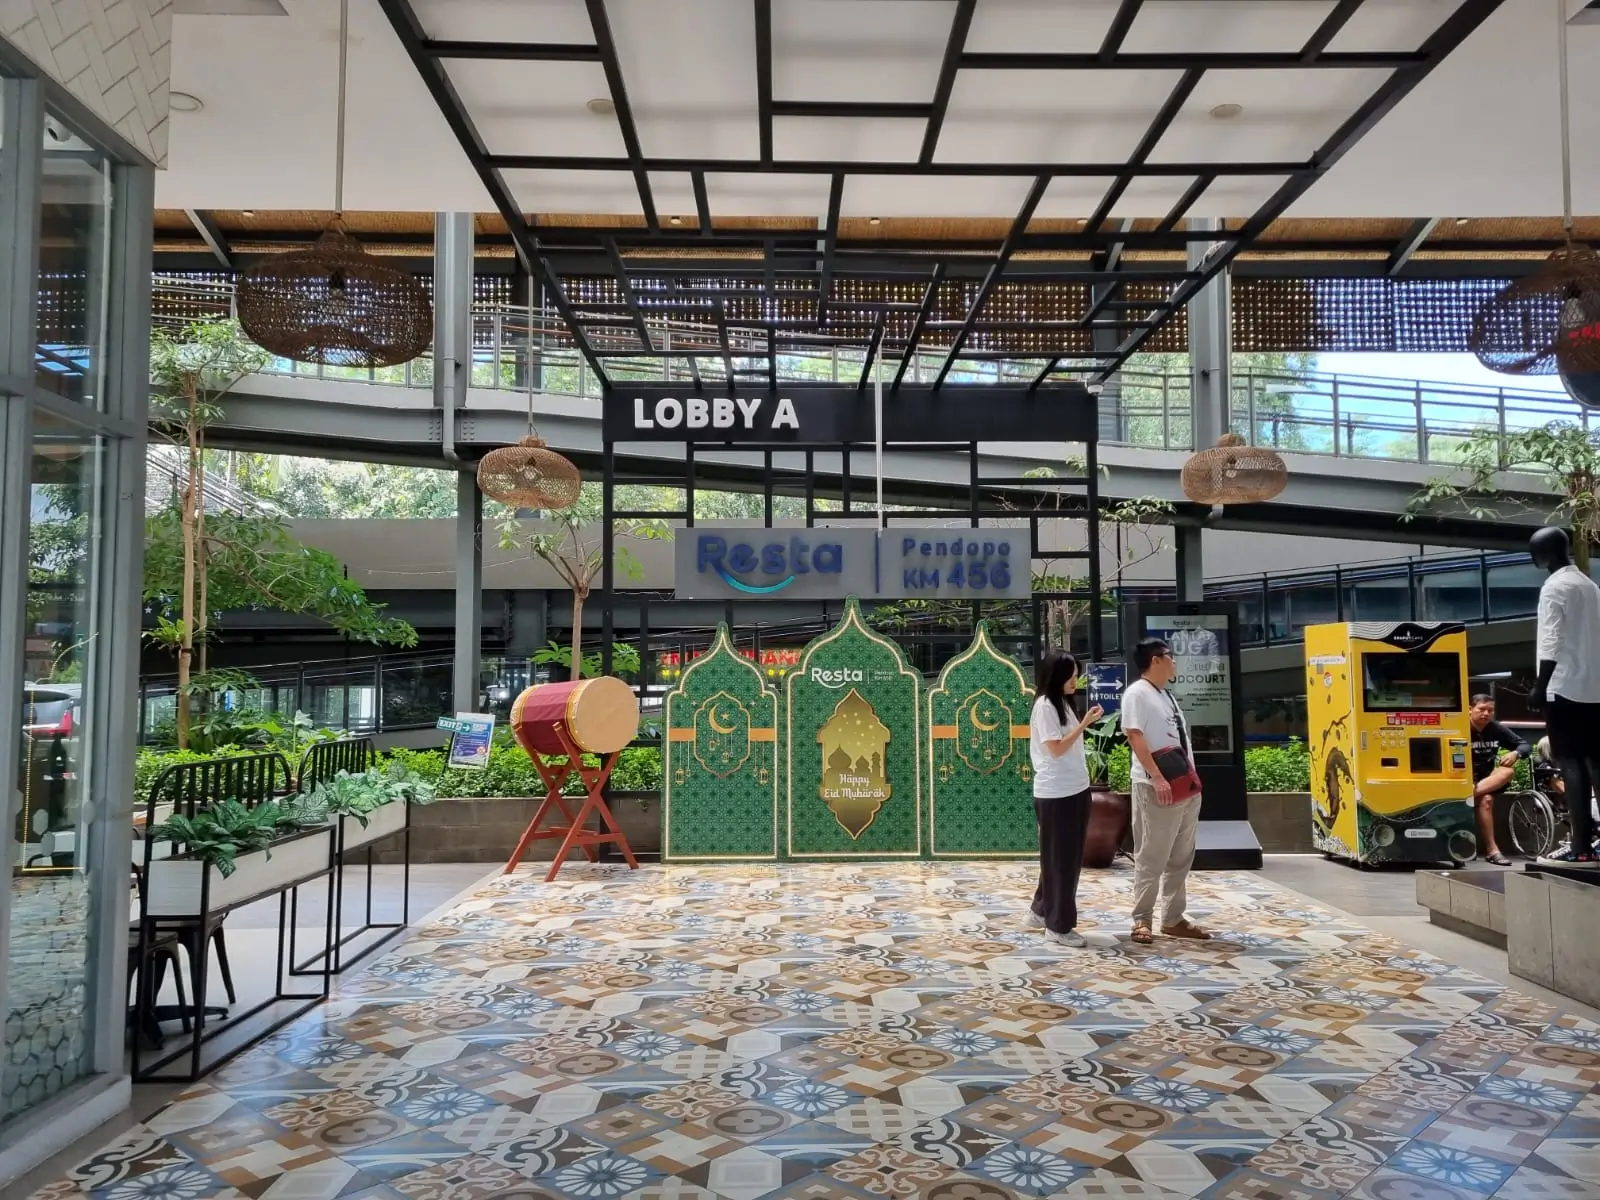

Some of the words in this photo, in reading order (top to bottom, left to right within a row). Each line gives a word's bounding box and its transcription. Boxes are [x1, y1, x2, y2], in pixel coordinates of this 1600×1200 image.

[634, 398, 762, 429] LOBBY
[771, 398, 800, 429] A
[696, 535, 843, 577] Resta
[902, 537, 1011, 560] Pendopo
[903, 569, 939, 589] KM
[945, 561, 1011, 590] 456
[811, 667, 863, 683] Resta
[1168, 674, 1226, 684] ODCOURT
[439, 719, 457, 729] EXIT
[824, 788, 840, 798] Eid
